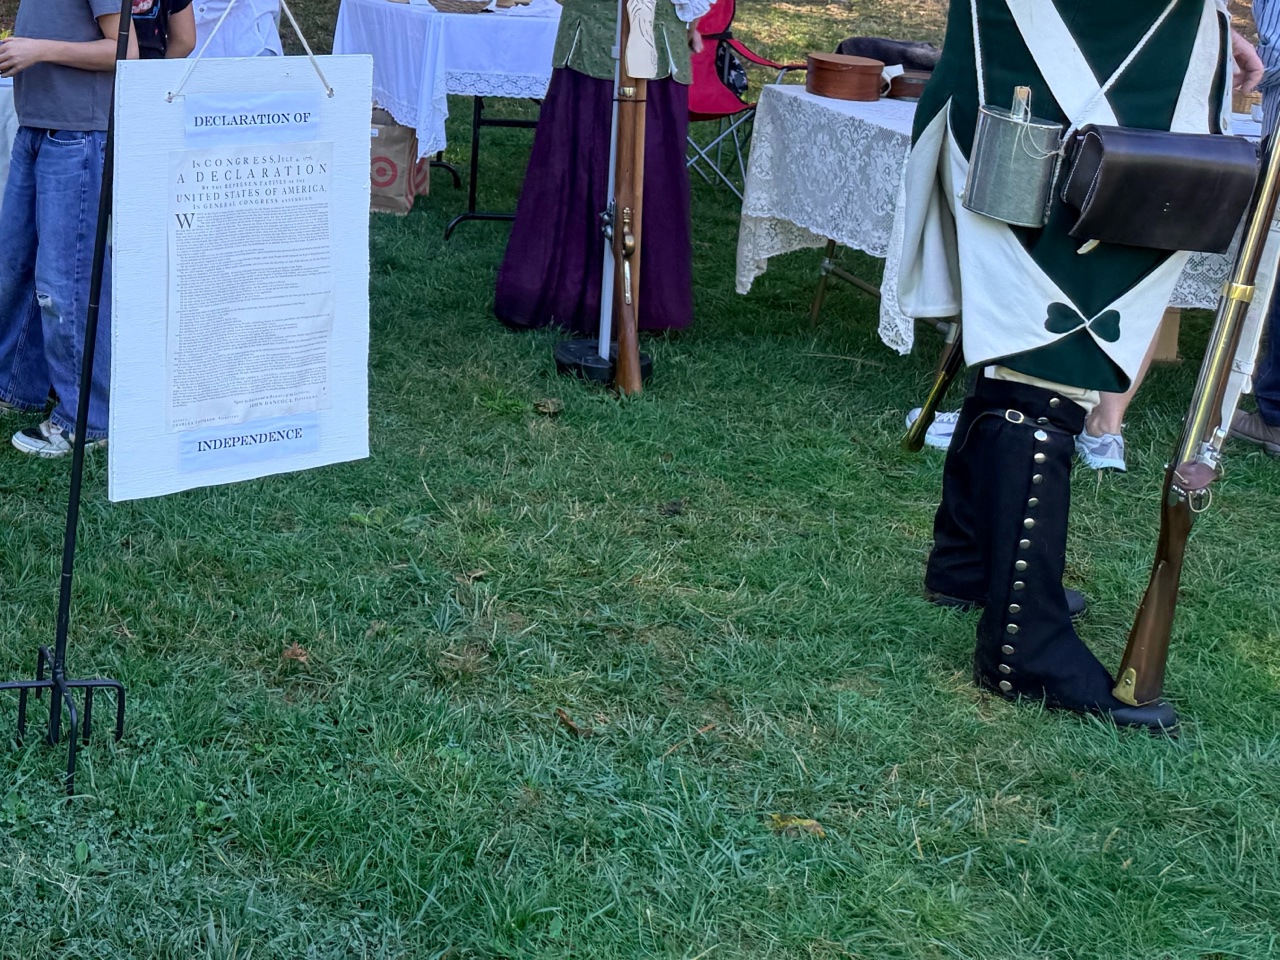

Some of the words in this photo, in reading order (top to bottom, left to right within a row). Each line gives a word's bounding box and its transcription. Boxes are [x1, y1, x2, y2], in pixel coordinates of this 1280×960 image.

[194, 113, 290, 128] DECLARATION
[293, 112, 311, 124] OF
[176, 173, 185, 184] A
[196, 163, 328, 183] DECLARATION
[176, 191, 220, 203] UNITED
[224, 189, 260, 200] STATES
[265, 187, 277, 196] OF
[239, 198, 278, 206] CONGRESS
[197, 427, 303, 452] INDEPENDENCE
